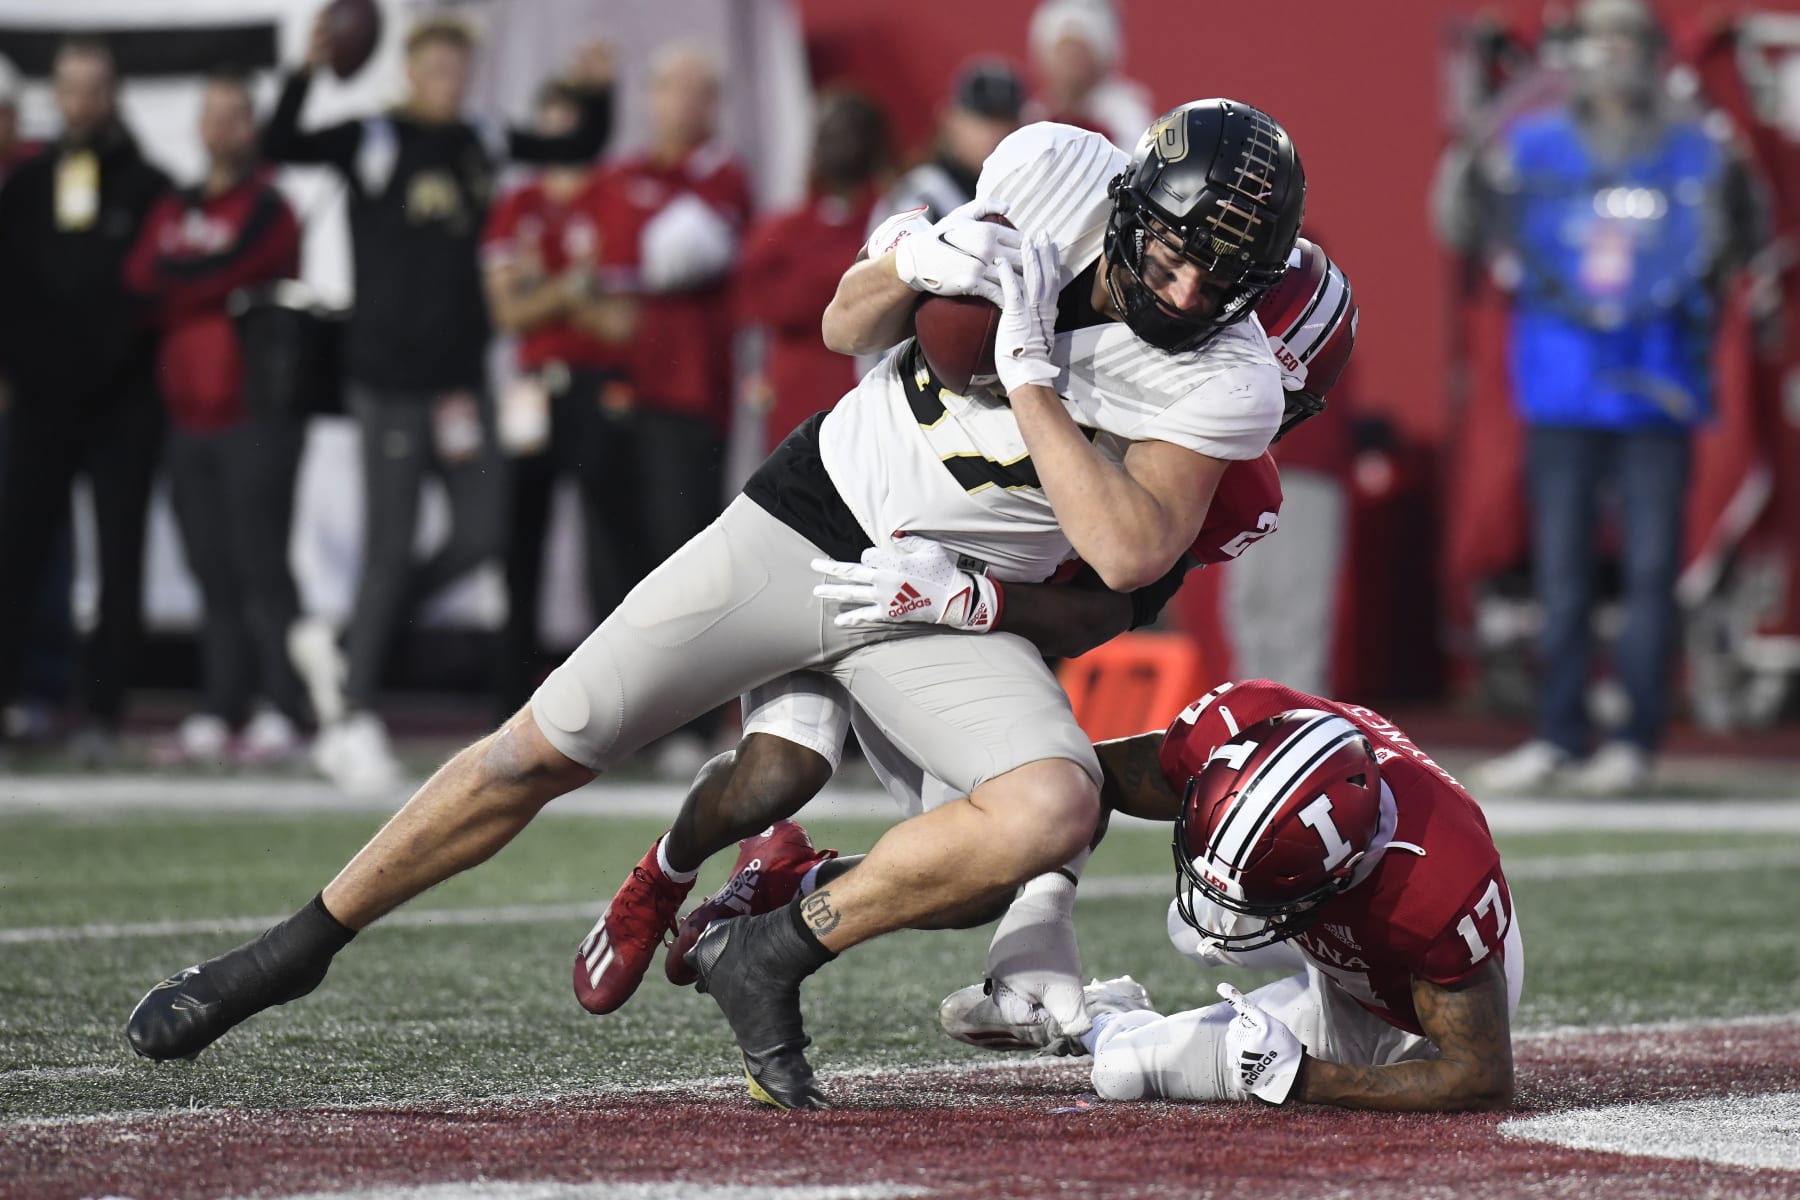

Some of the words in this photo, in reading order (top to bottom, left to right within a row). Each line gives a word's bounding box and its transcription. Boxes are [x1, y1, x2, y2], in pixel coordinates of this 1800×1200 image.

[1274, 345, 1299, 372] LEO
[888, 597, 932, 618] adidas
[1296, 792, 1353, 872] I
[714, 858, 761, 906] adidas
[1203, 869, 1228, 893] LEO
[1456, 879, 1508, 965] 17
[1244, 1050, 1278, 1087] adidas
